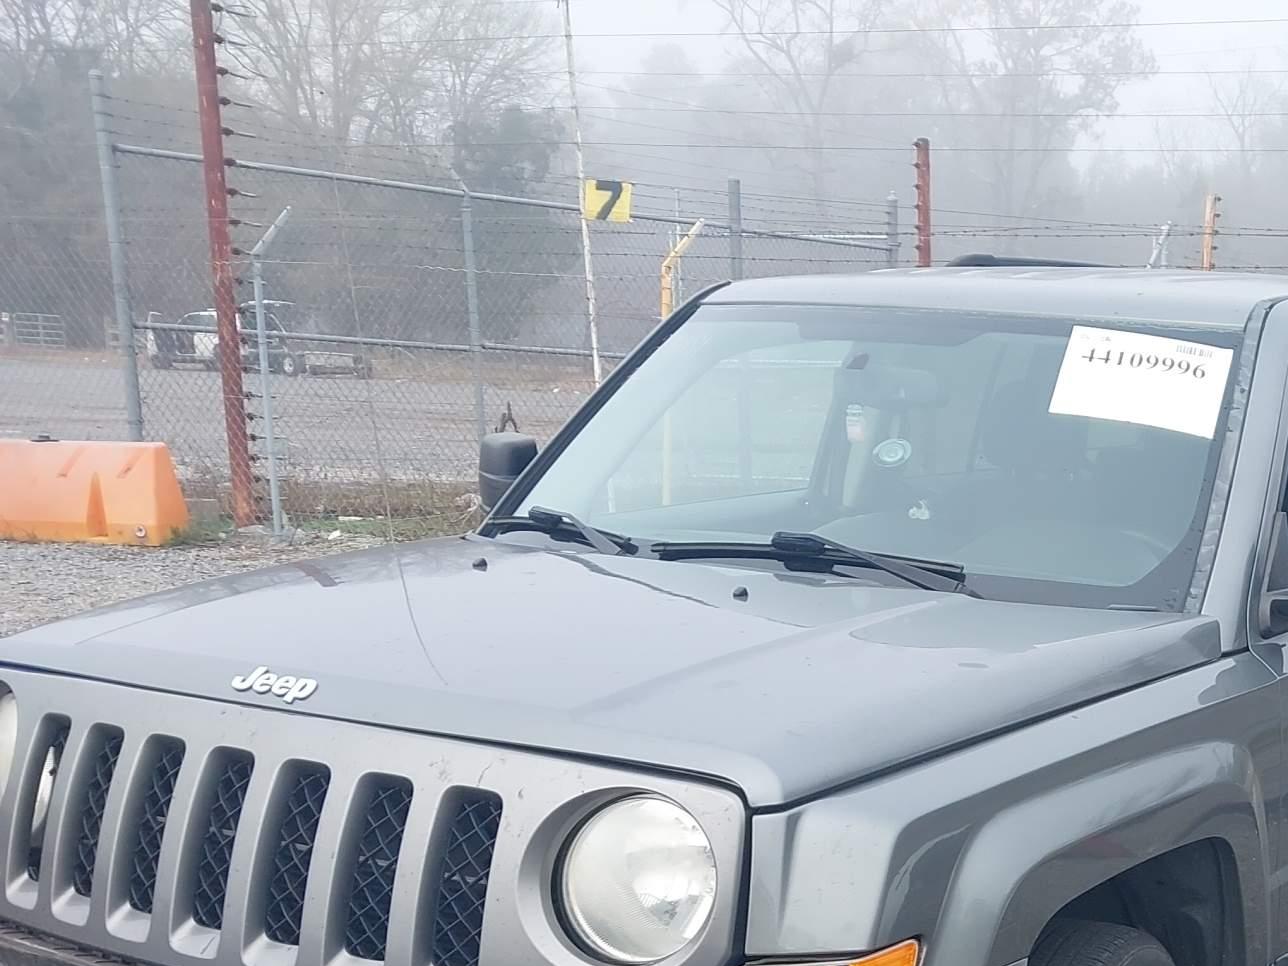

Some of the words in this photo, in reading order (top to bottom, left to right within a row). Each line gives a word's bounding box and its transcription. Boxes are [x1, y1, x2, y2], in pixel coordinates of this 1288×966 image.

[595, 180, 623, 220] 7
[1081, 347, 1206, 379] 44109996
[231, 665, 318, 704] Jeep
